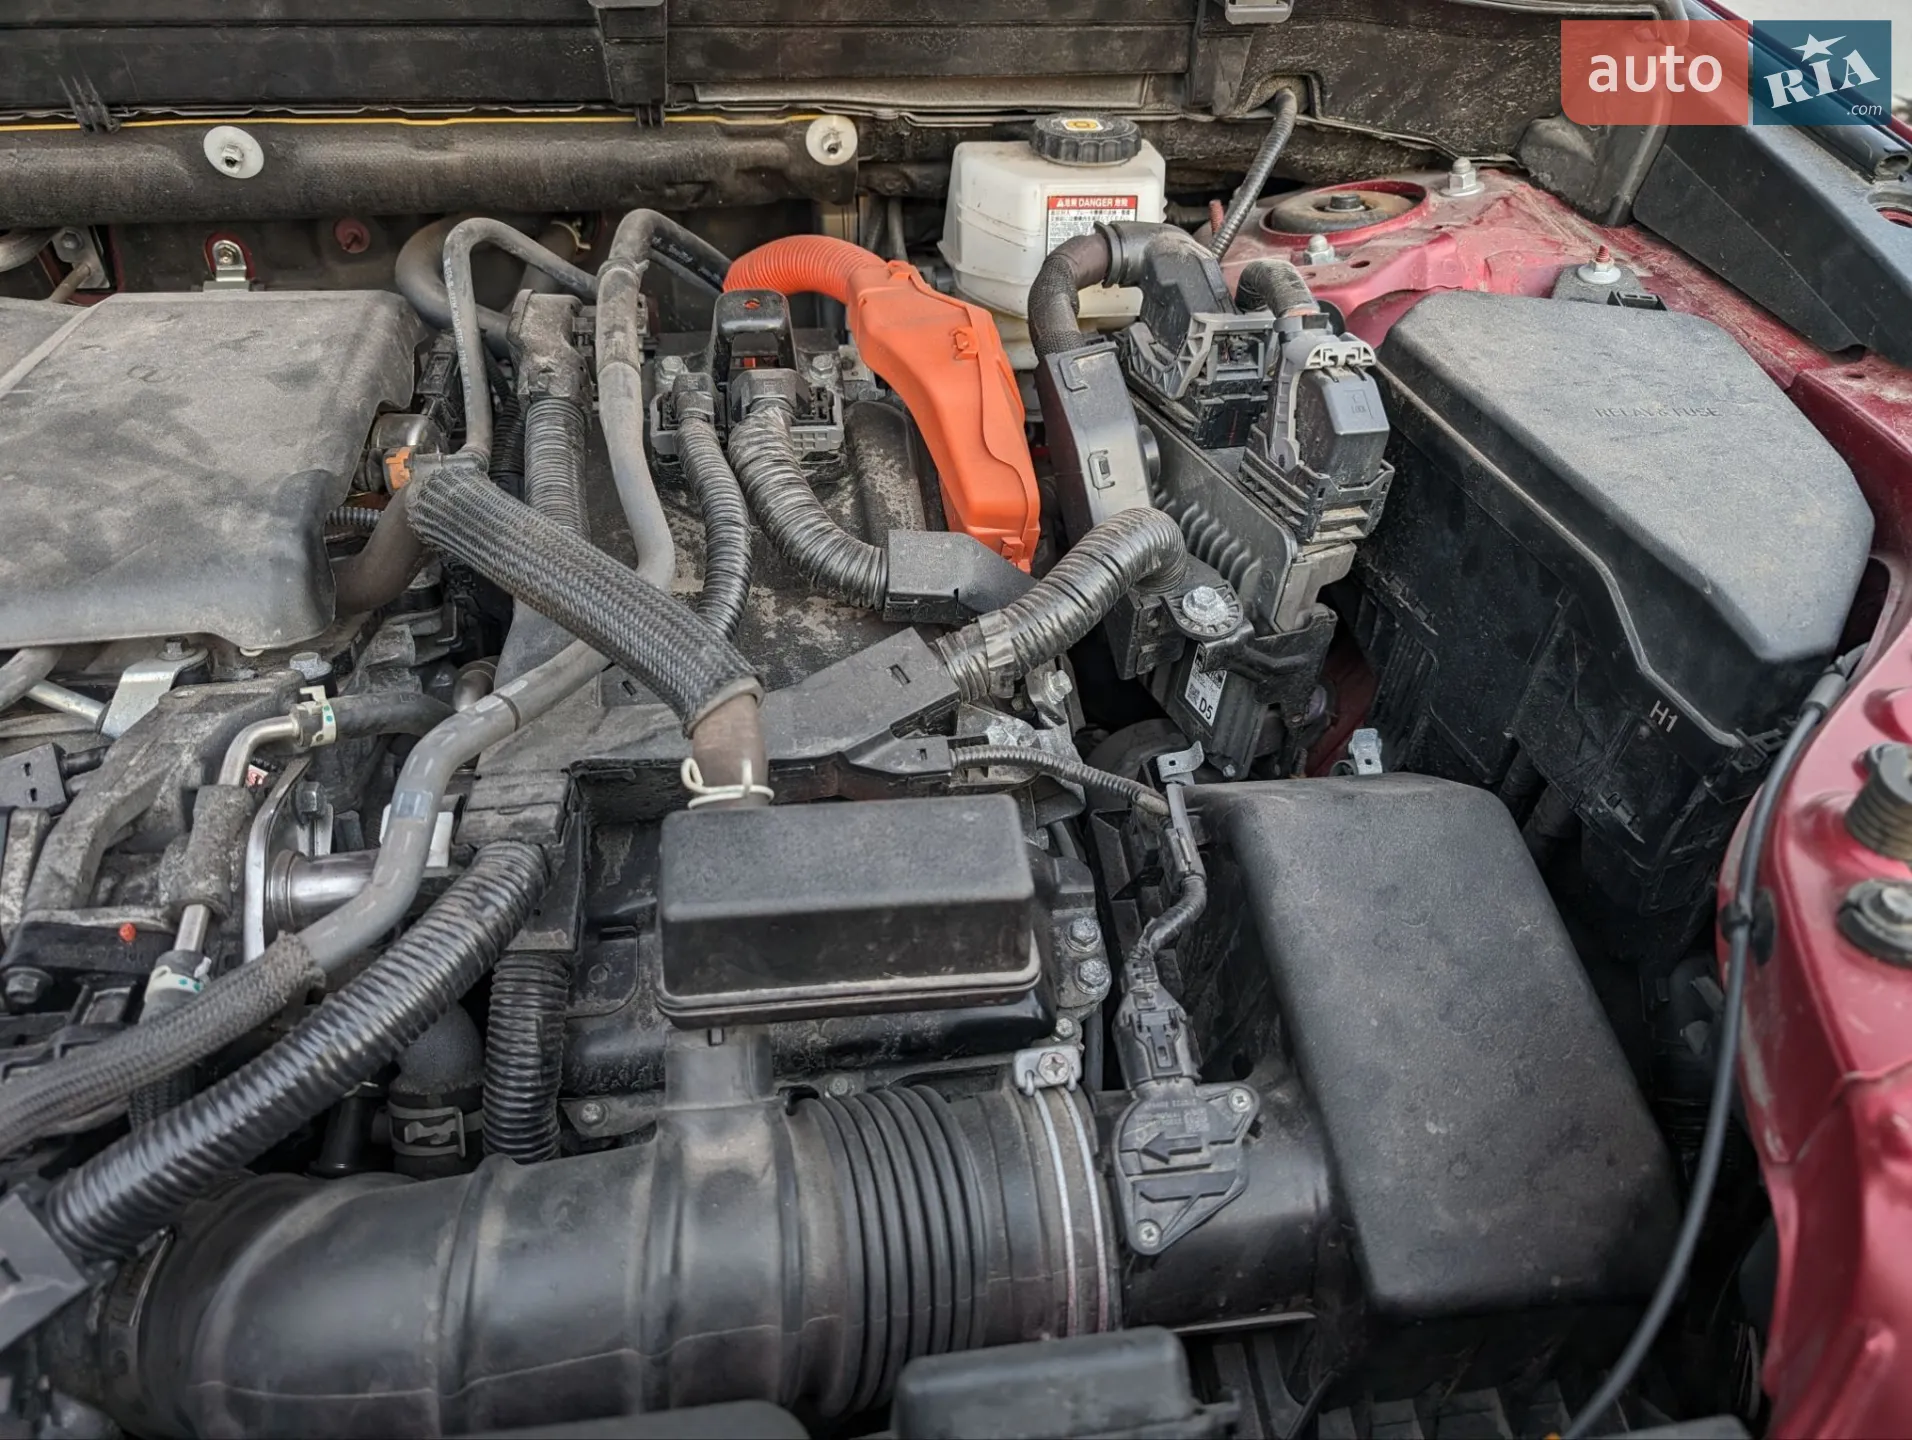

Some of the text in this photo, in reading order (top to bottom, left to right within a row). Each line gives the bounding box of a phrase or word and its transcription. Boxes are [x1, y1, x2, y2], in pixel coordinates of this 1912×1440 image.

[1079, 197, 1113, 207] DANGER
[1199, 698, 1213, 719] D5
[1650, 701, 1677, 732] H1
